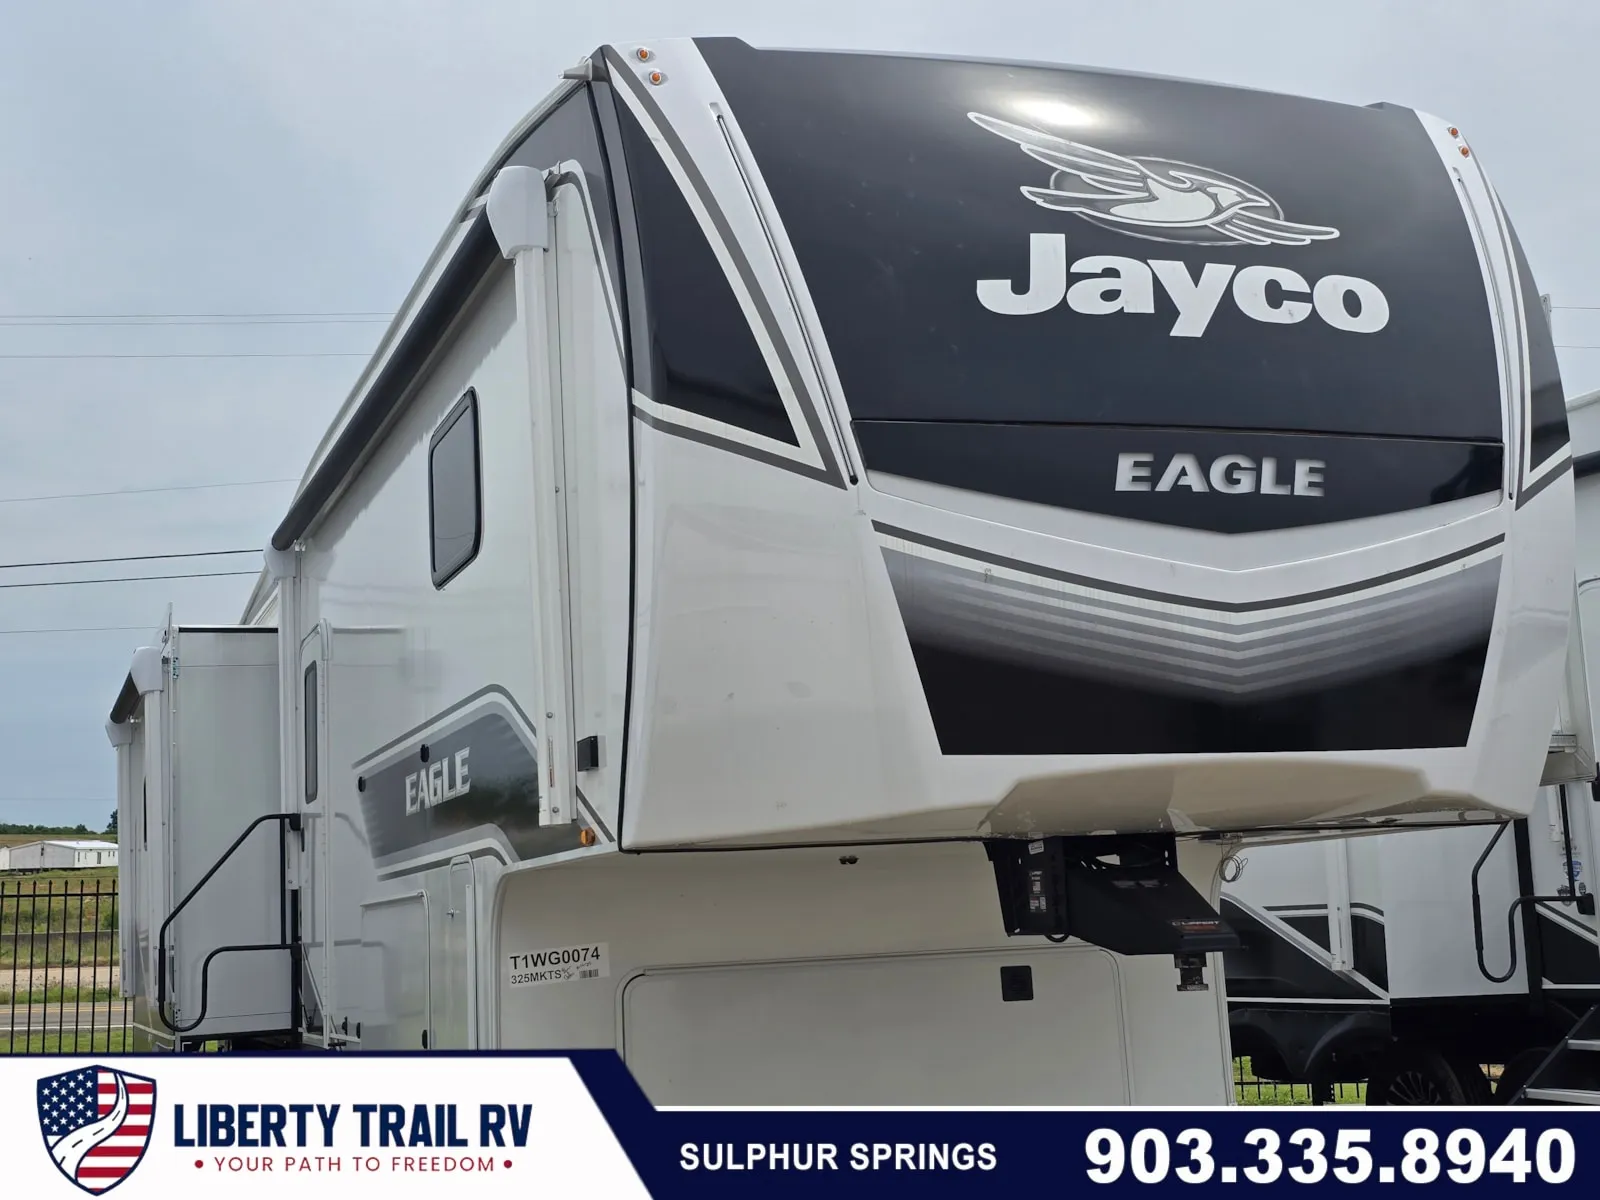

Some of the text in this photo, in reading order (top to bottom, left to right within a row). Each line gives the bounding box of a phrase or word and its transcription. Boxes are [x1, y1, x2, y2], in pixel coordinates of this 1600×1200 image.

[977, 233, 1389, 337] Jayco
[1115, 453, 1326, 496] EAGLE
[405, 747, 471, 816] EAGLE
[509, 946, 600, 970] T1WG0074
[511, 969, 562, 985] 325MKTS
